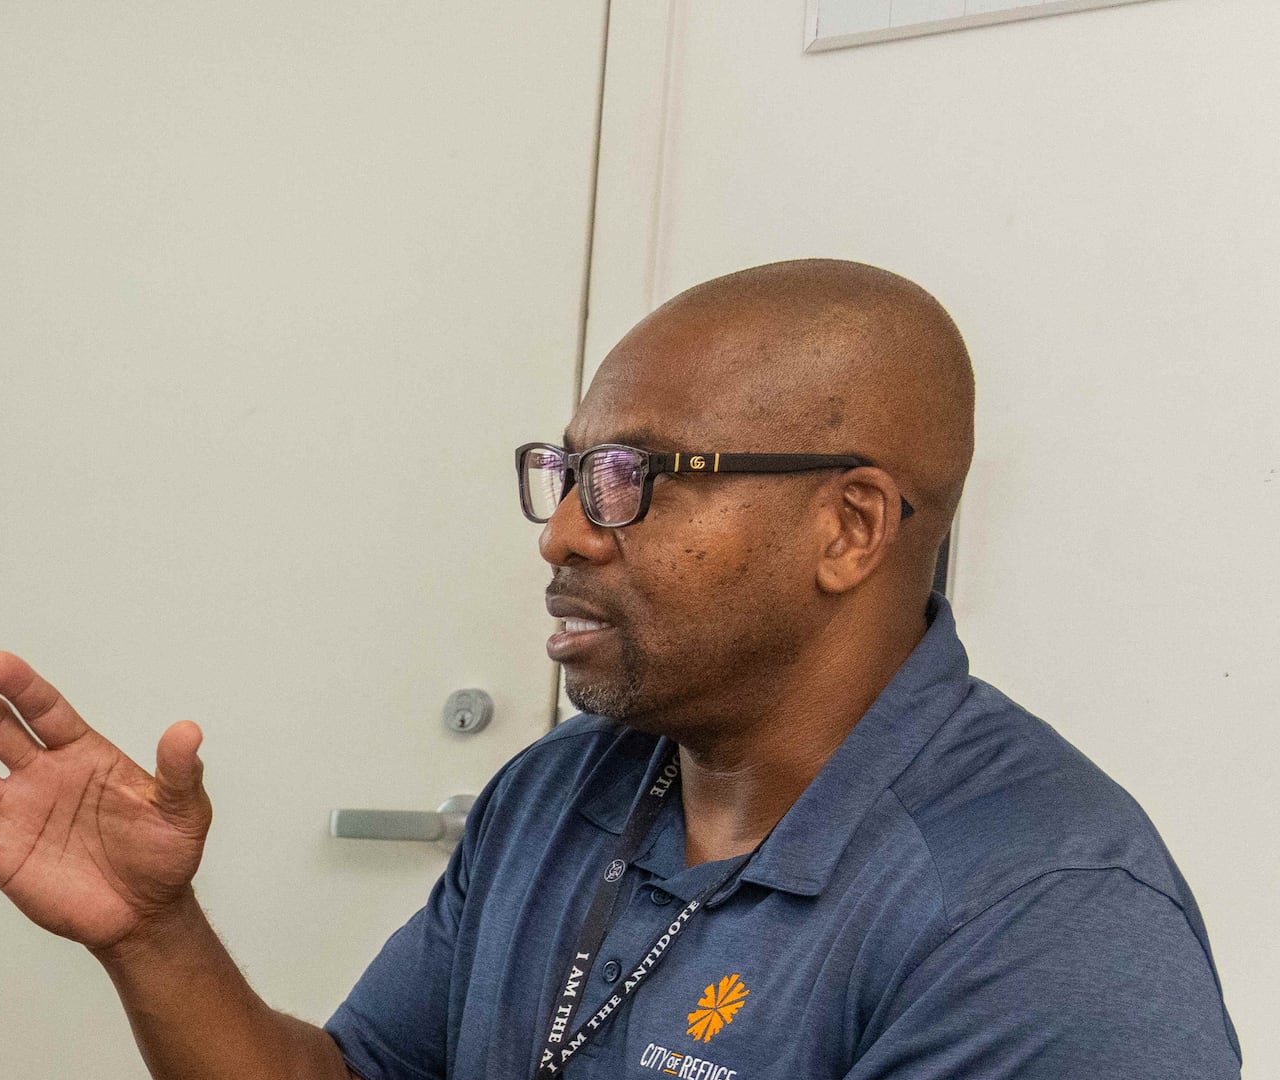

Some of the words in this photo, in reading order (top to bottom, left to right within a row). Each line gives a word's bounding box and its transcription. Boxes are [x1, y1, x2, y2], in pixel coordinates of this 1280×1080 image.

[576, 952, 590, 961] I
[547, 1062, 558, 1073] I
[561, 1032, 587, 1062] AM
[587, 995, 622, 1030] THE
[624, 900, 700, 994] ANTIDOTE
[563, 965, 584, 998] AM
[548, 1004, 571, 1043] THE
[640, 1043, 672, 1071] CITY
[666, 1056, 682, 1070] OF
